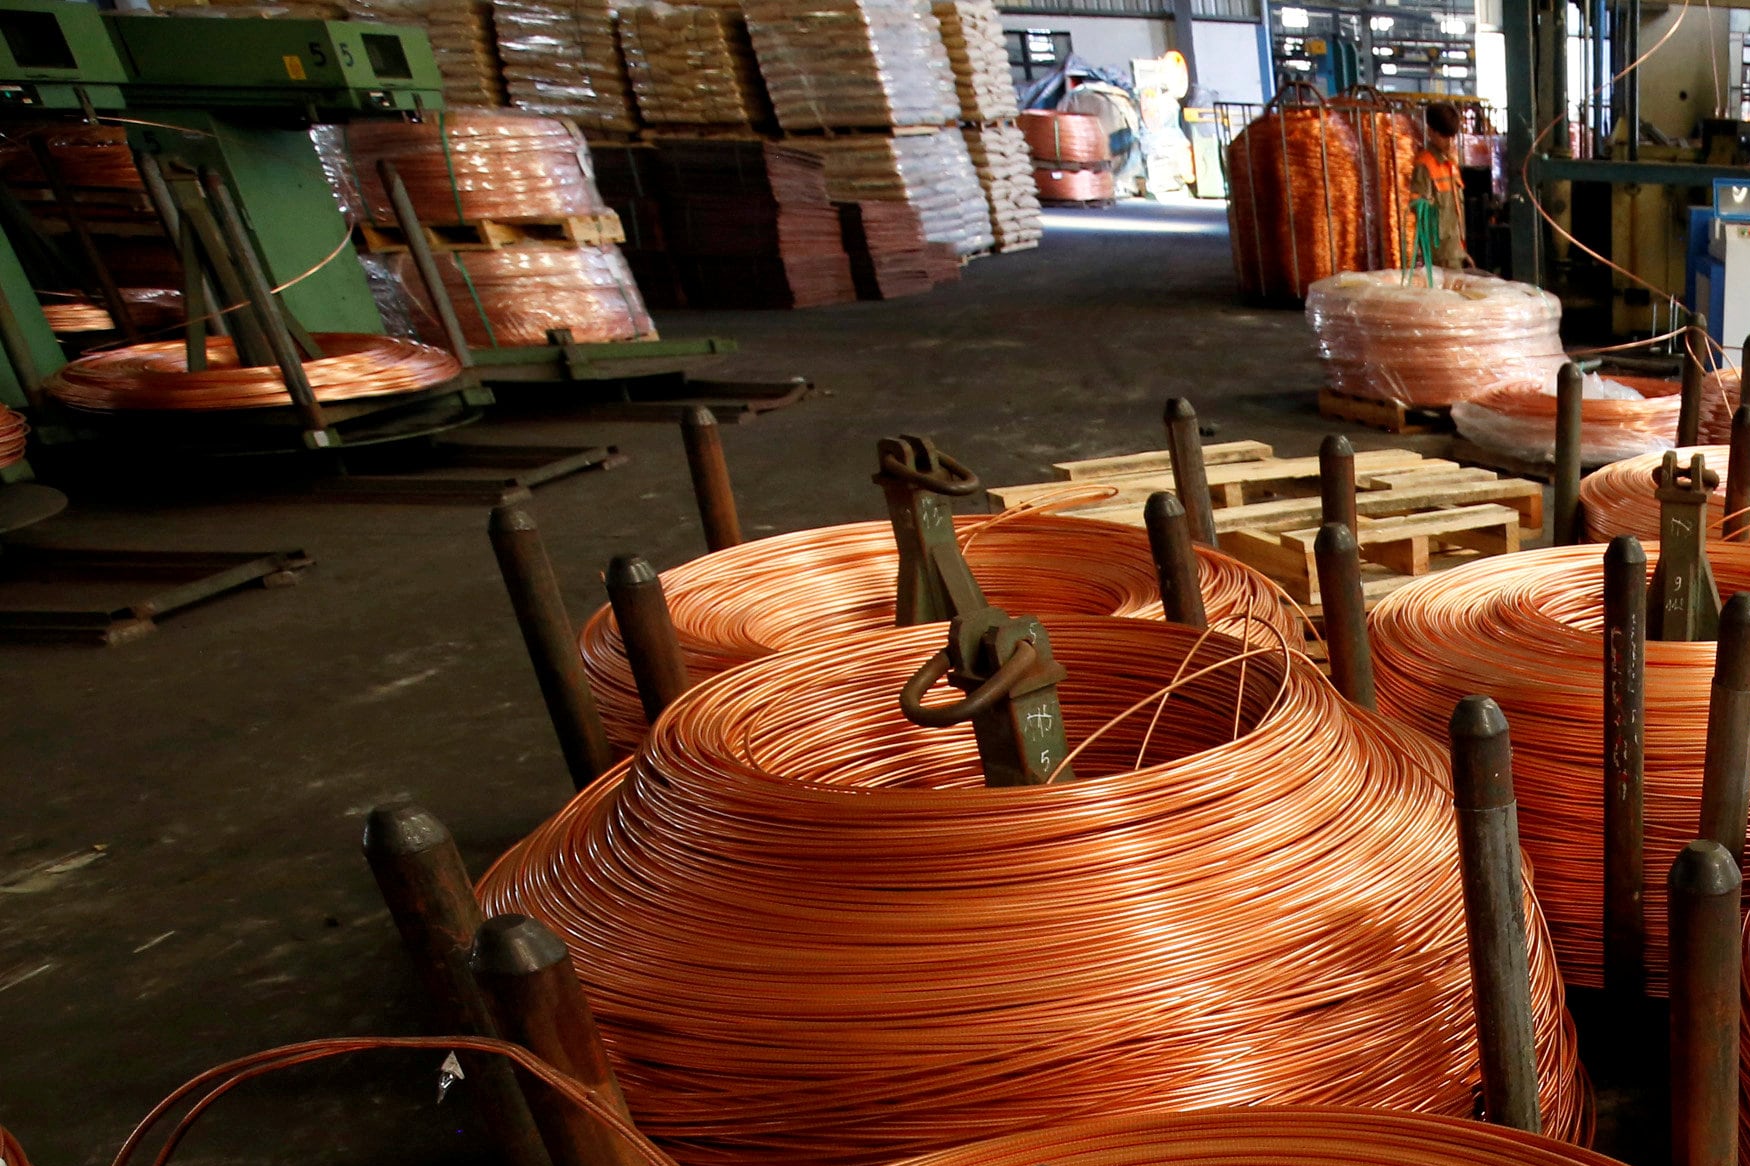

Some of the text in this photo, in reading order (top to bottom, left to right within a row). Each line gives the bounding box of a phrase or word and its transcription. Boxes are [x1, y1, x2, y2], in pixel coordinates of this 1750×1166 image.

[309, 42, 327, 67] 5
[339, 42, 355, 67] 5
[1040, 749, 1051, 773] 5
